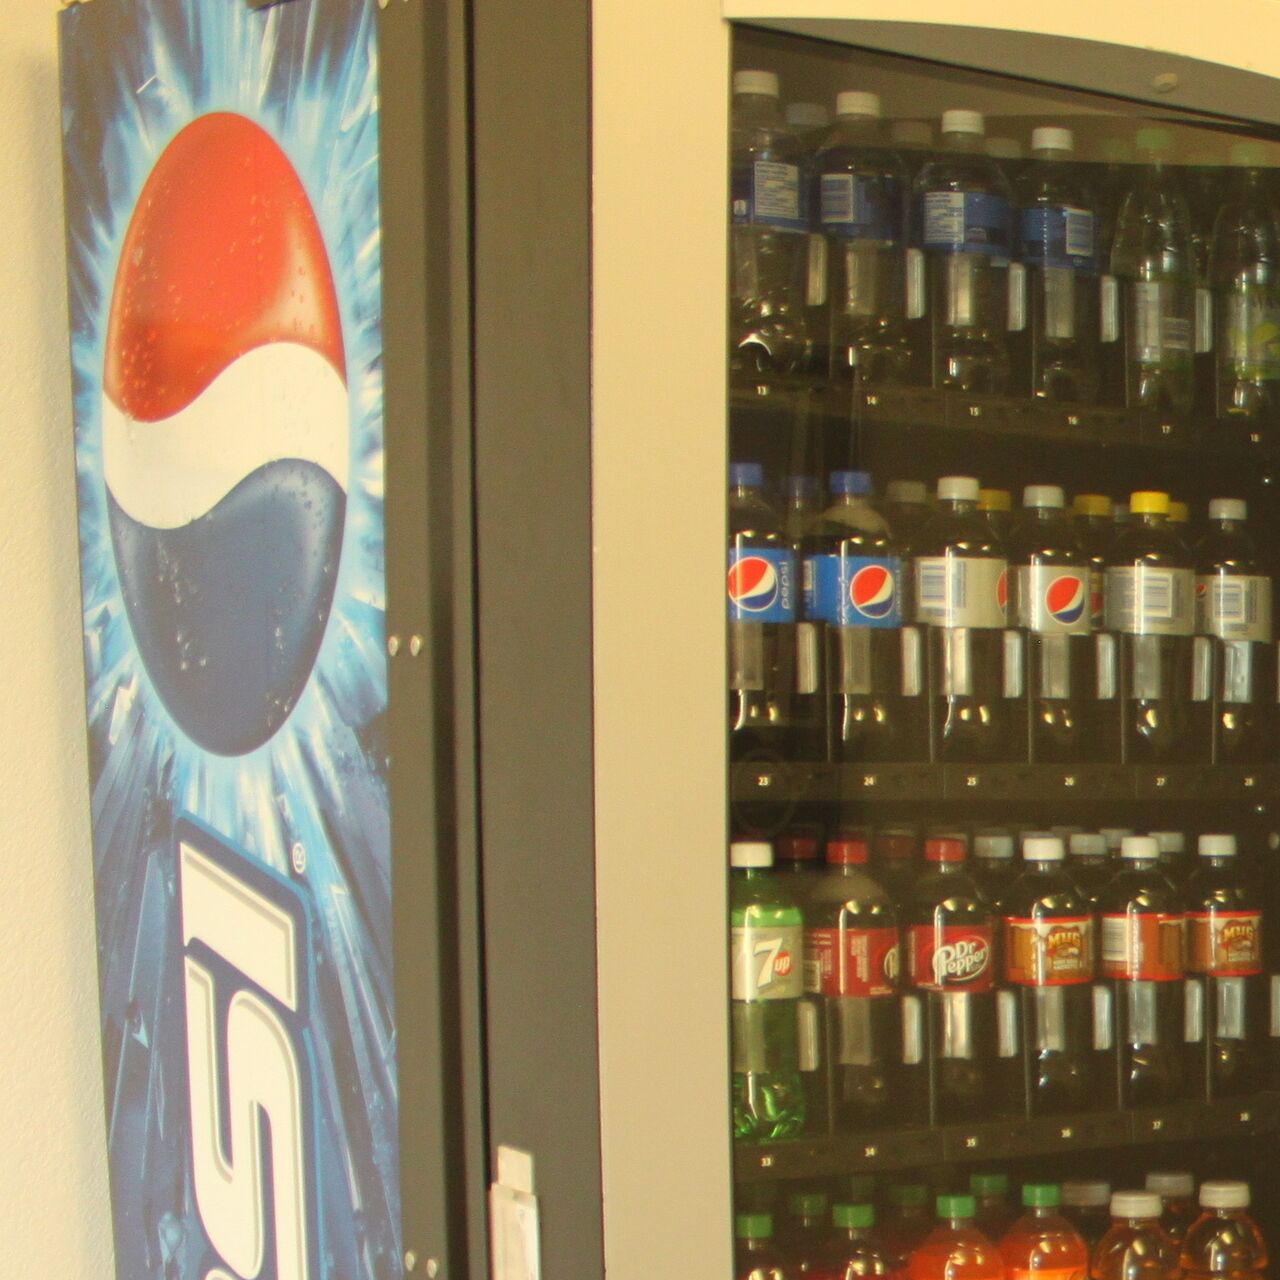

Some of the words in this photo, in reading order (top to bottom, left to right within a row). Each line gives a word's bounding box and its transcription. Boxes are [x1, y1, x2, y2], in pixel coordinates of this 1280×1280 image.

[1048, 926, 1081, 947] MUG
[1223, 925, 1255, 947] MUG
[955, 939, 977, 960] Dr
[753, 937, 784, 989] 7
[775, 956, 791, 976] up
[933, 946, 987, 988] Pepper
